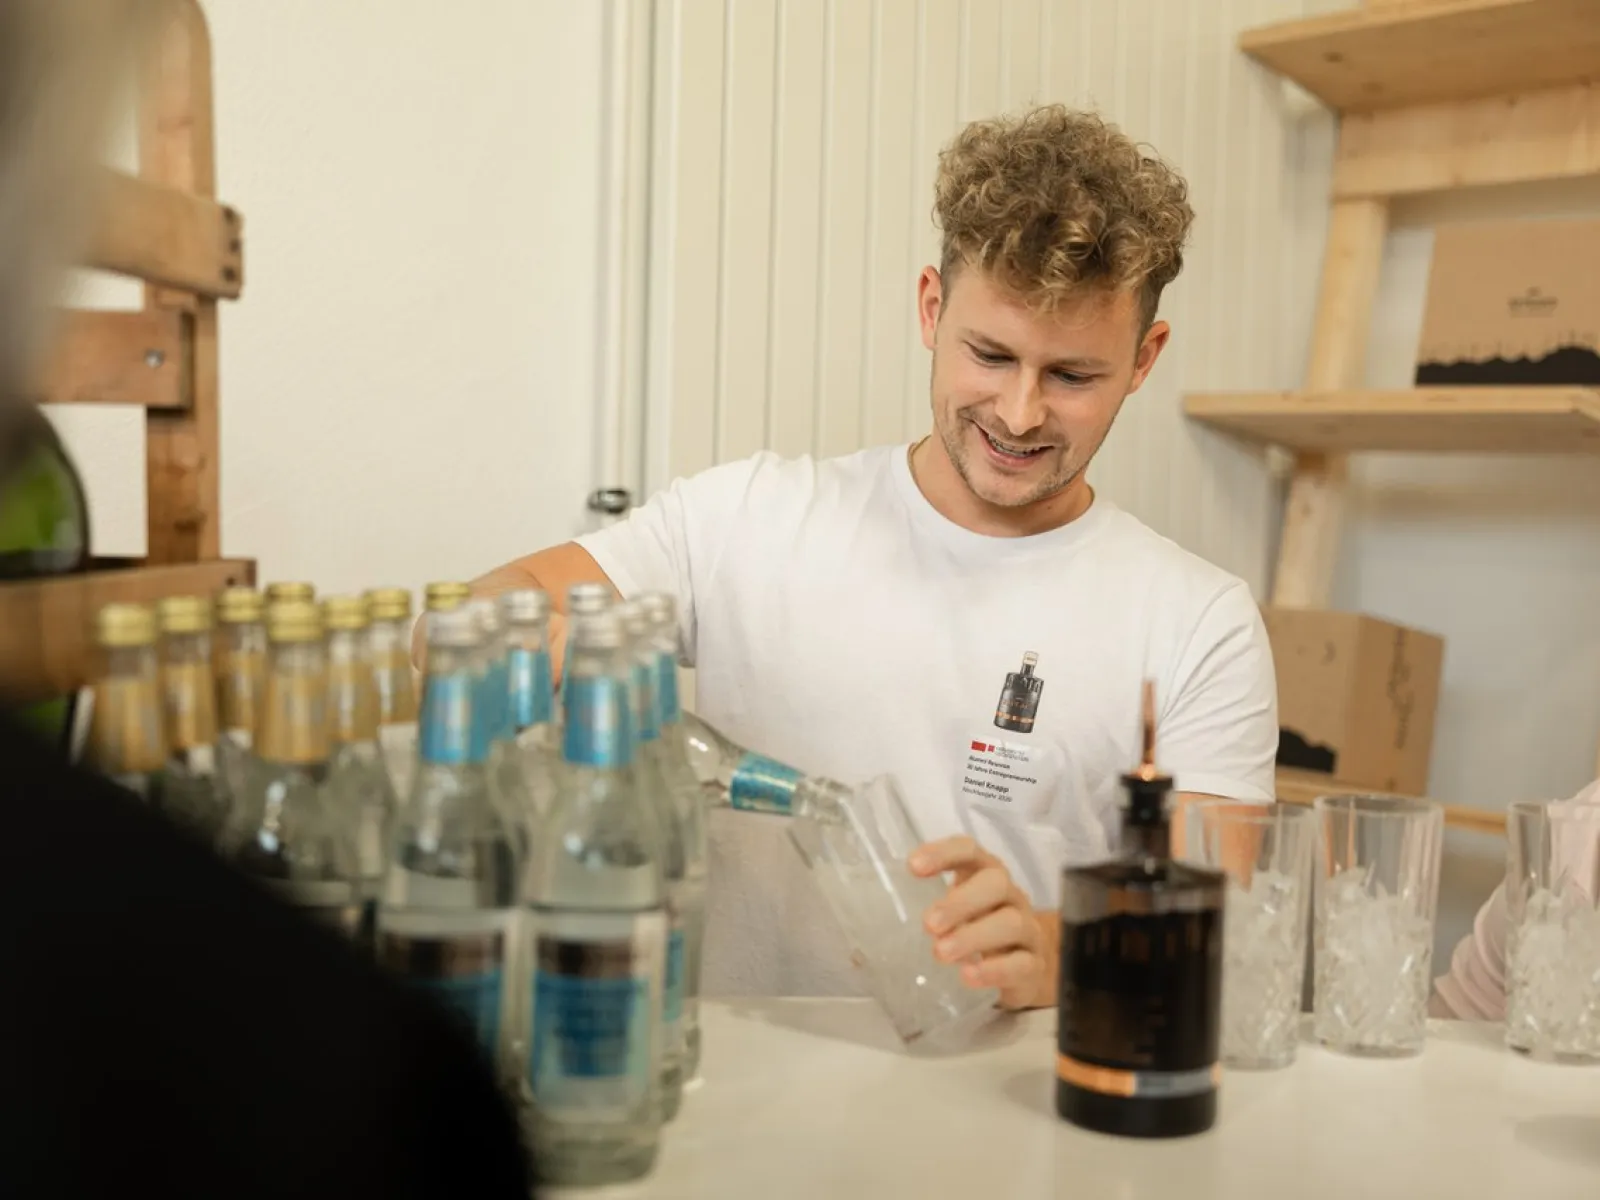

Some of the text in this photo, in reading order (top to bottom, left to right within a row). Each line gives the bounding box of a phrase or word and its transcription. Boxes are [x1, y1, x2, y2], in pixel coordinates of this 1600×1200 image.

[964, 776, 1009, 793] Daniel Knapp
[989, 769, 1037, 784] Entrepreneurship
